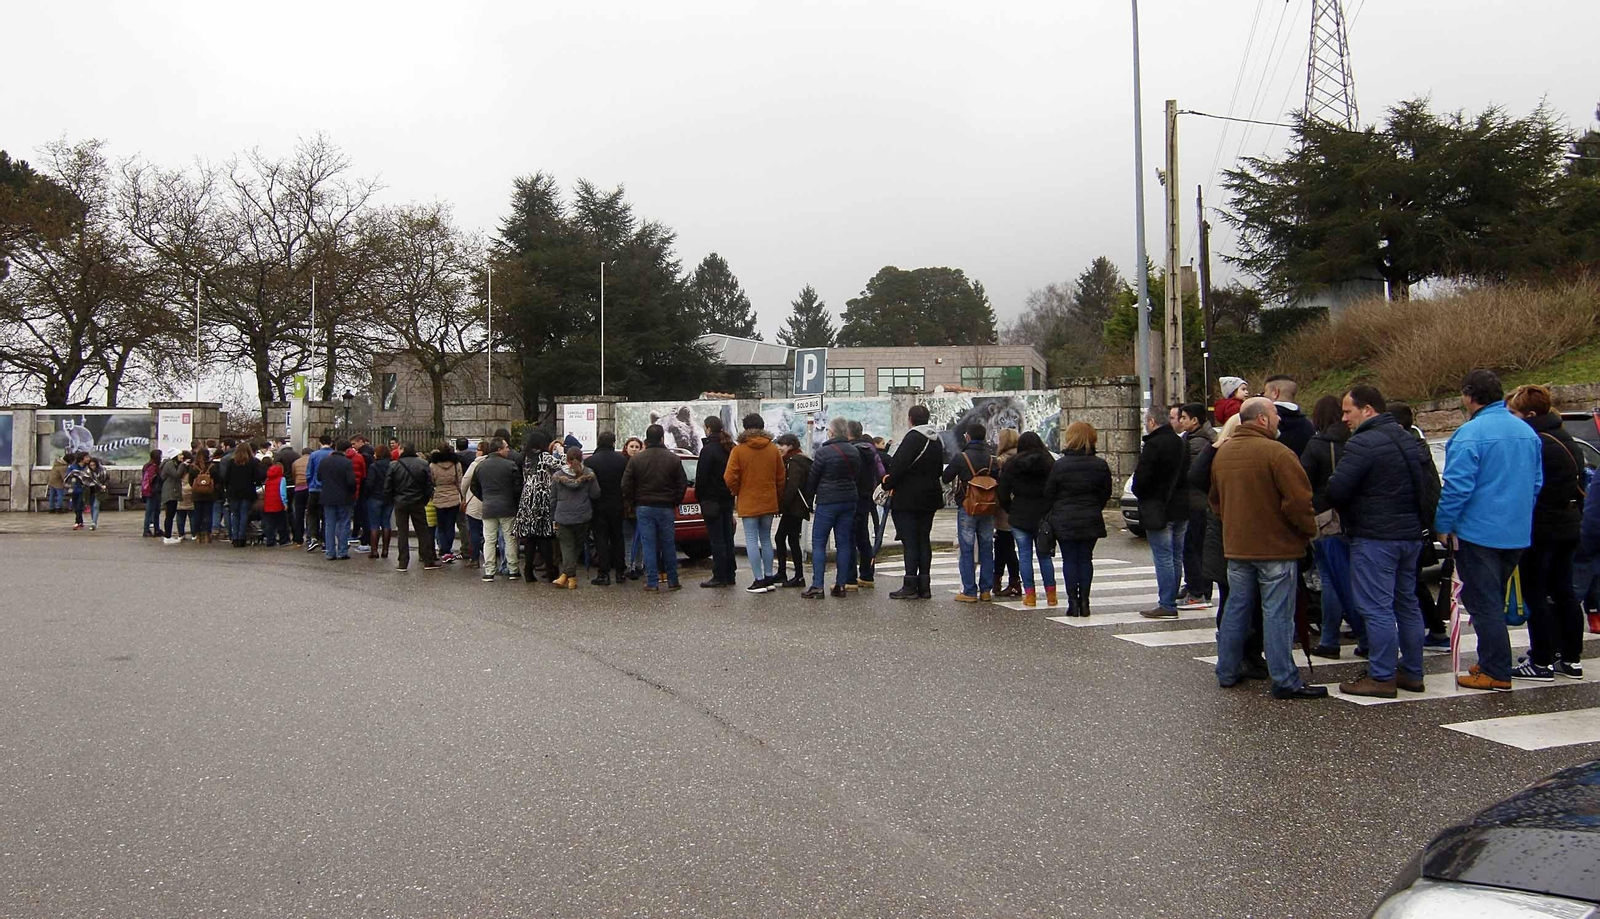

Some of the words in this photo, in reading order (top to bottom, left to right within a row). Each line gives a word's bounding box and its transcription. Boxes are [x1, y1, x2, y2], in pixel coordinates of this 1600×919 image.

[802, 353, 818, 391] P
[809, 400, 819, 408] BUS
[683, 504, 700, 513] 8759
